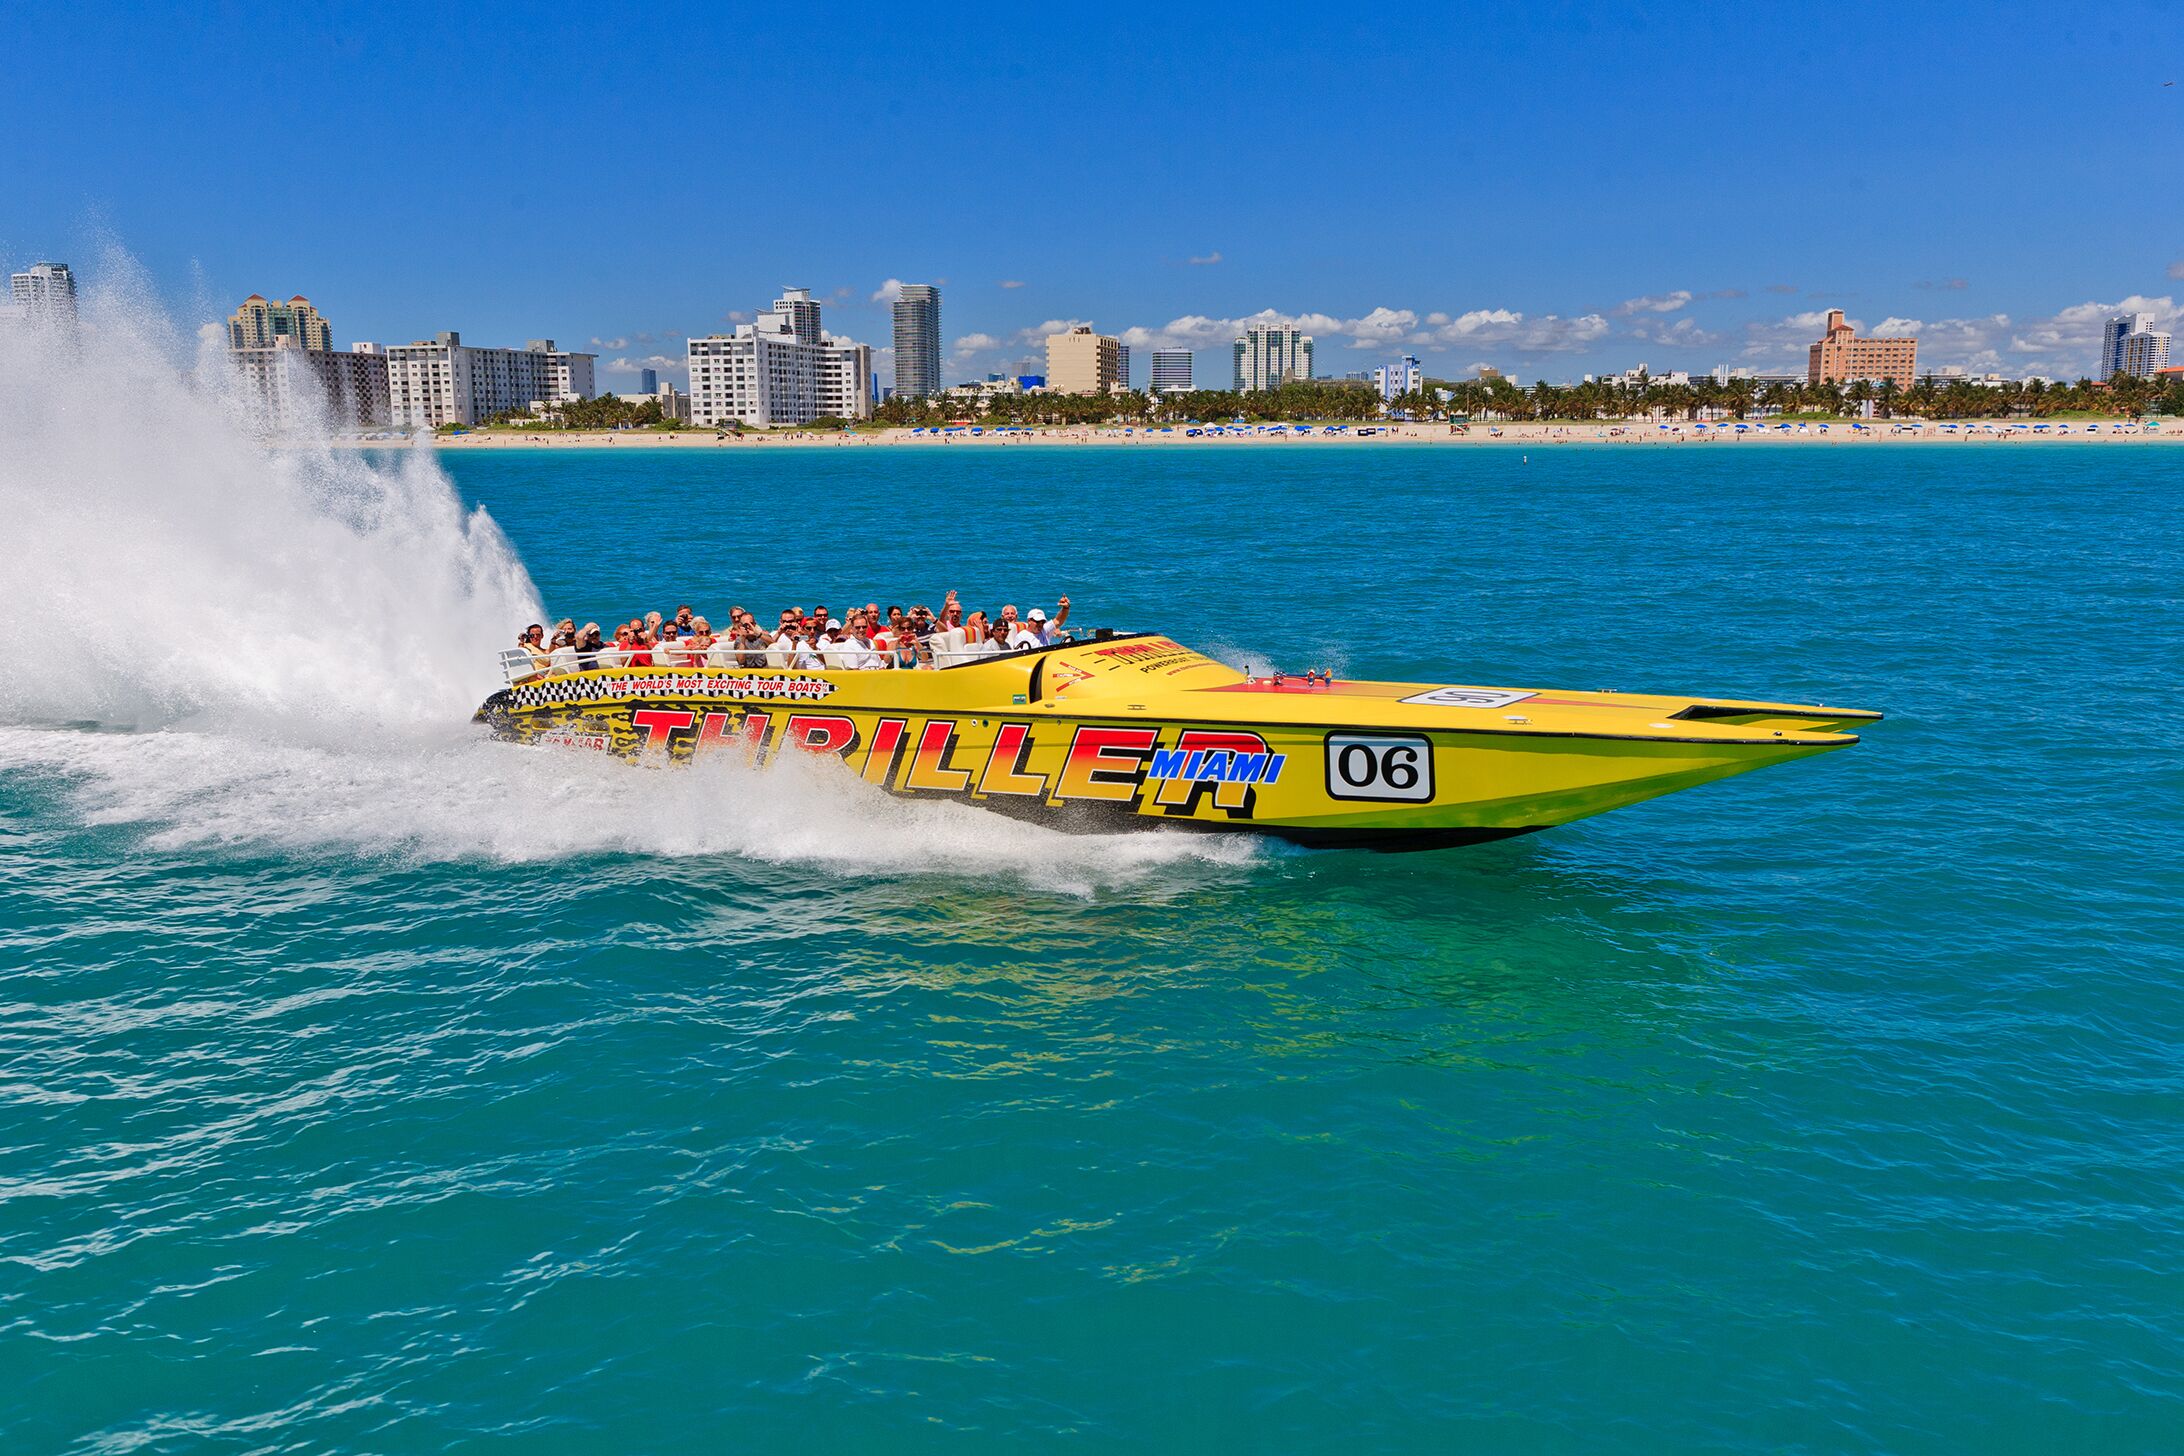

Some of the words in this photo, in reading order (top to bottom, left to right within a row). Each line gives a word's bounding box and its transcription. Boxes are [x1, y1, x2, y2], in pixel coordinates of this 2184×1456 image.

[632, 679, 673, 690] WORLD'S
[676, 679, 703, 689] MOST
[707, 679, 752, 690] EXCITING
[757, 681, 783, 691] TOUR
[631, 708, 1269, 809] THRILLER
[1147, 747, 1288, 785] MIAMI
[1337, 743, 1419, 790] 06
